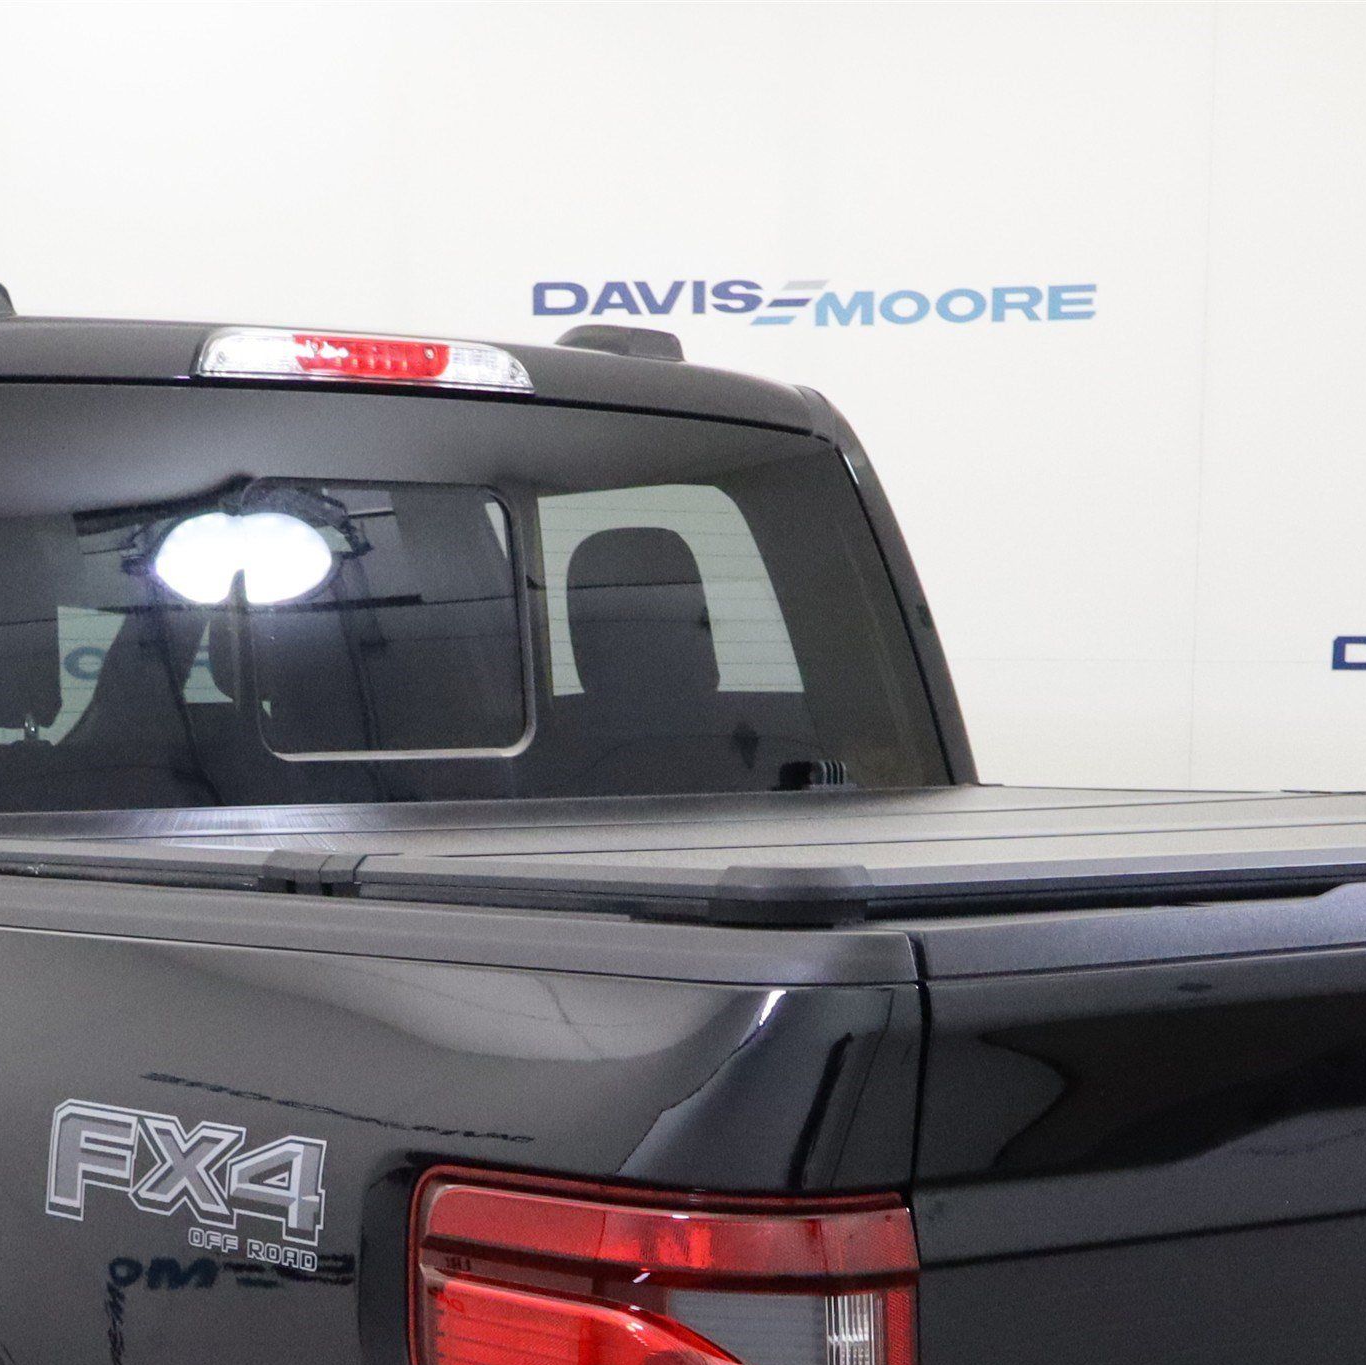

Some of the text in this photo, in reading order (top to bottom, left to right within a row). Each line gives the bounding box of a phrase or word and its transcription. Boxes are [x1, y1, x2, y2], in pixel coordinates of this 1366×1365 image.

[532, 279, 1097, 327] DAVIS MOORE
[45, 1098, 327, 1246] FX4
[187, 1226, 240, 1254] OFF
[246, 1238, 318, 1273] ROAD
